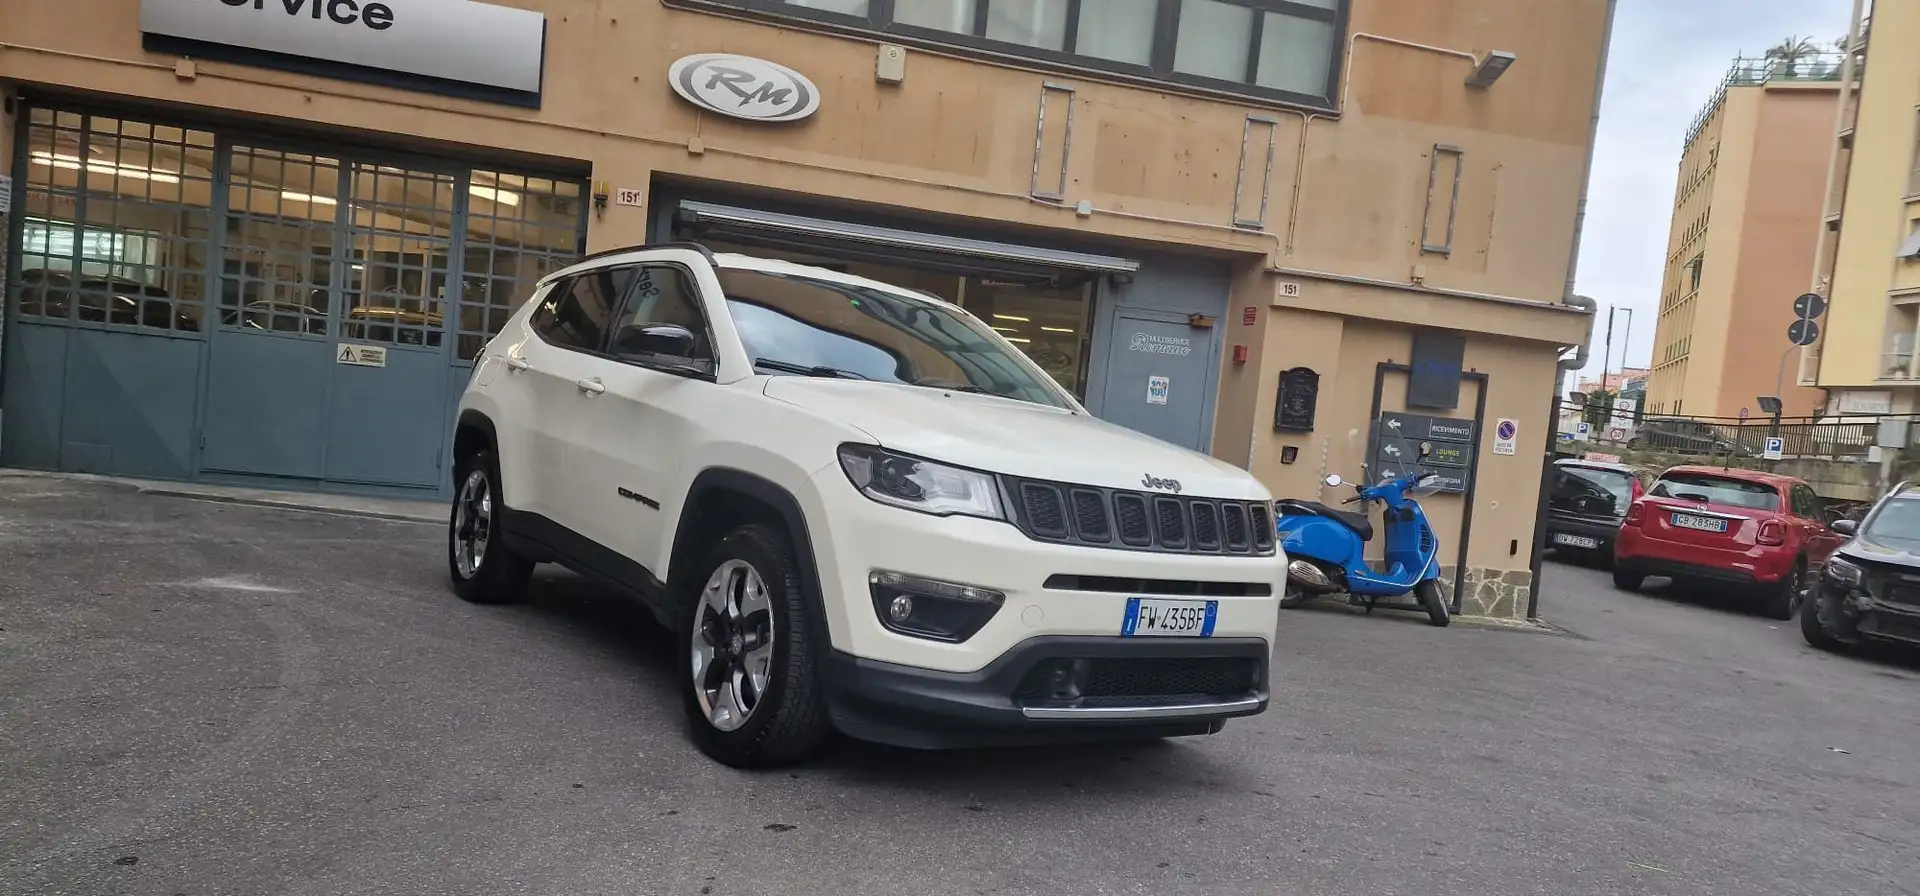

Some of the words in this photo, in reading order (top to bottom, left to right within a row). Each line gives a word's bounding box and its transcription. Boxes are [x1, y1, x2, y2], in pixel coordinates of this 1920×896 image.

[220, 0, 394, 30] vice
[705, 65, 792, 107] RM
[1283, 284, 1297, 295] 151
[1432, 425, 1470, 436] RICEVIMENTO
[1436, 448, 1460, 457] LOUNGE
[1768, 439, 1779, 451] P
[1141, 473, 1183, 494] Jeep
[1137, 605, 1158, 631] FW
[1160, 606, 1206, 632] 435BF
